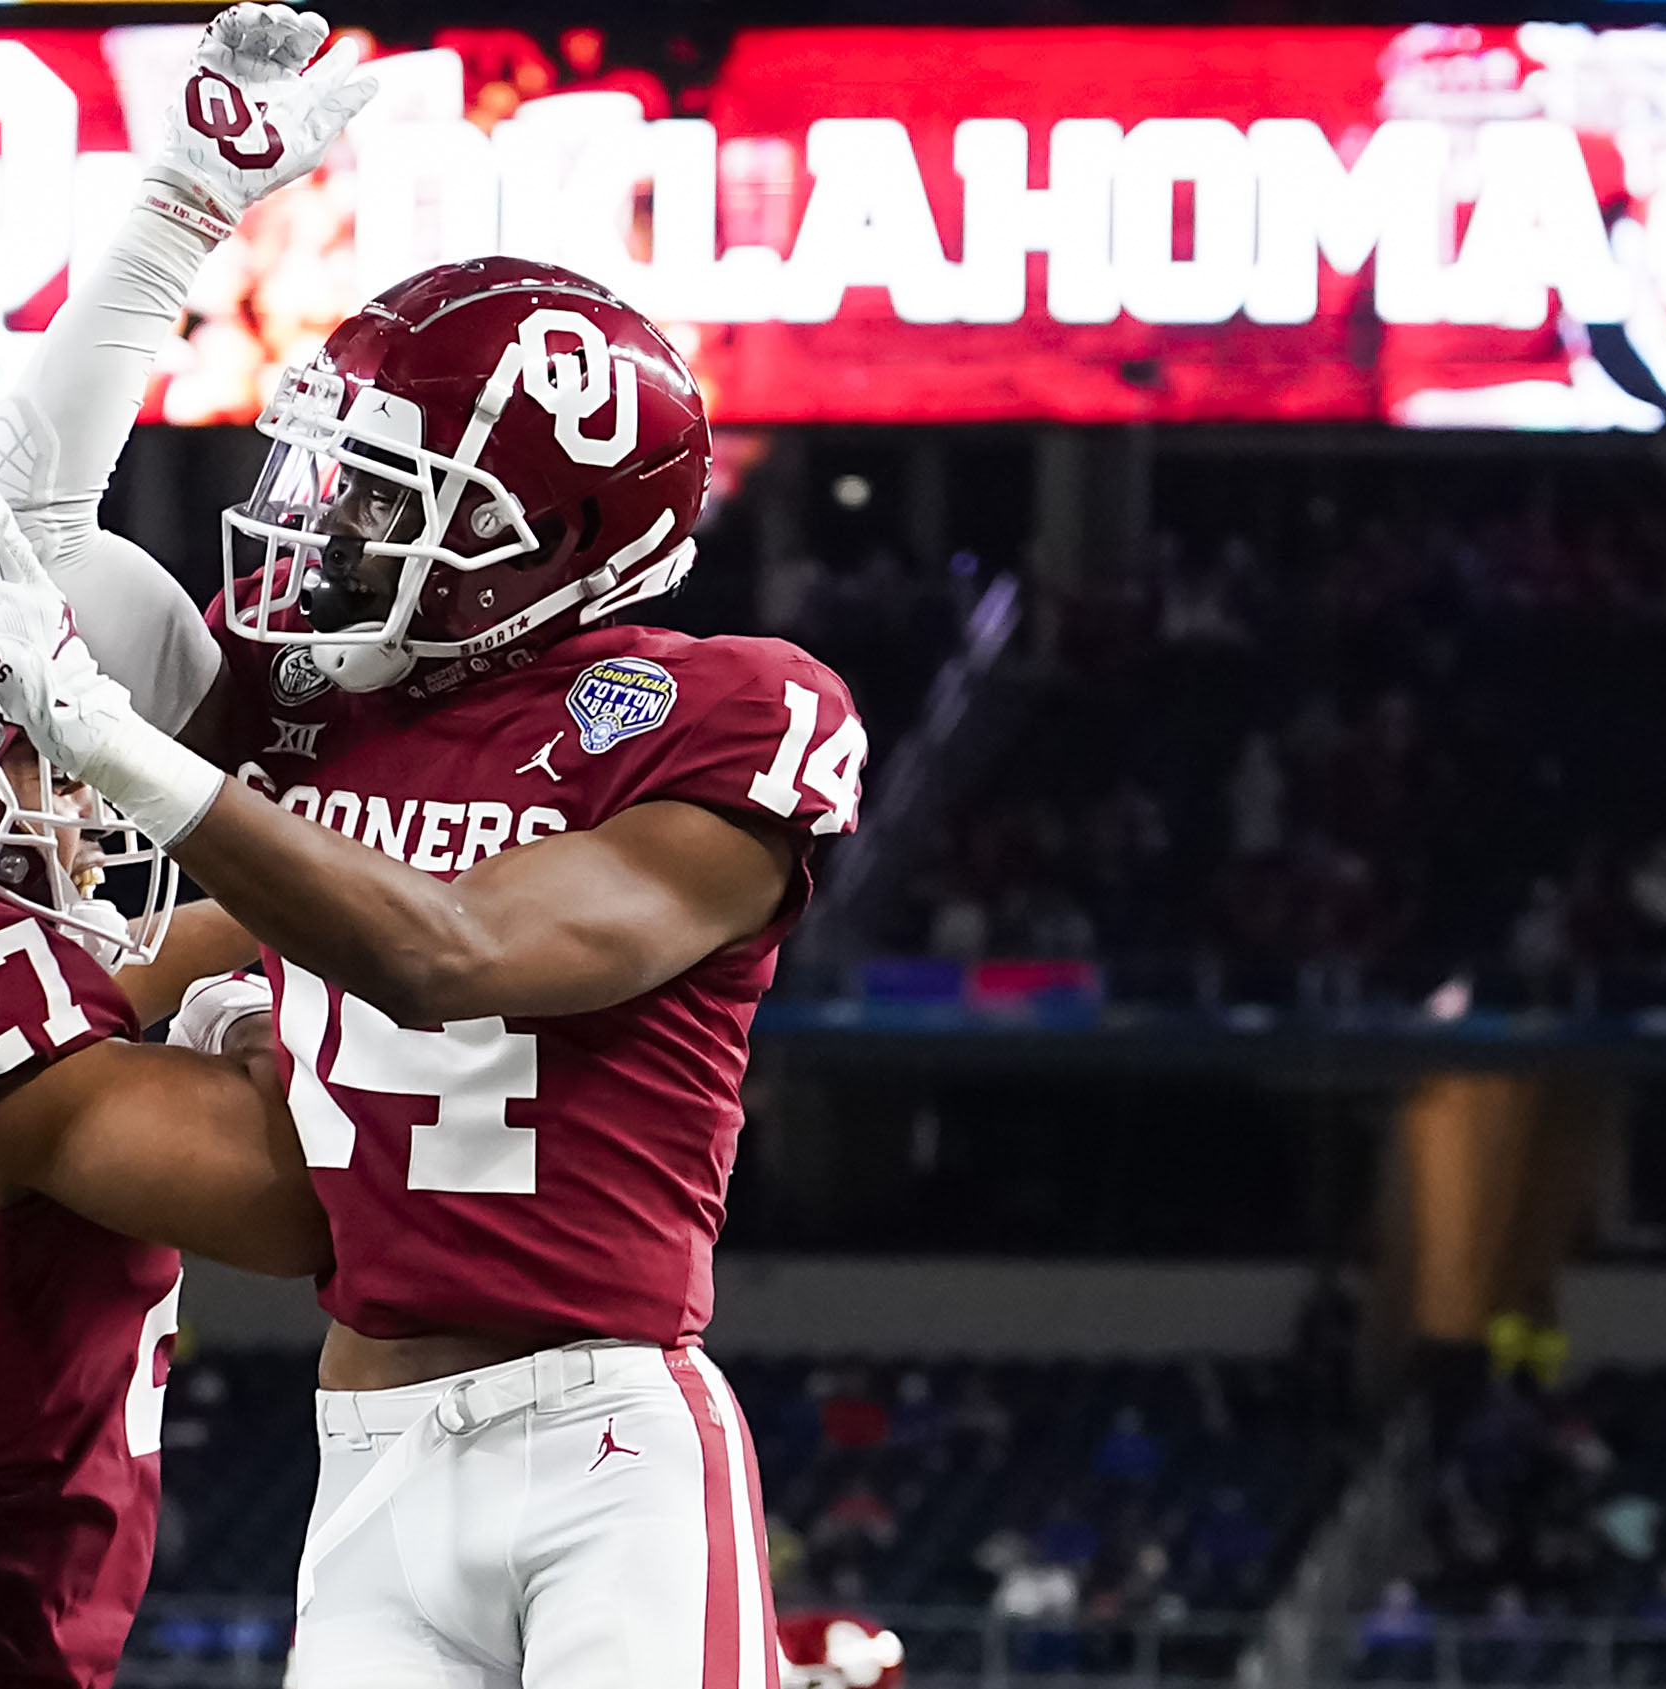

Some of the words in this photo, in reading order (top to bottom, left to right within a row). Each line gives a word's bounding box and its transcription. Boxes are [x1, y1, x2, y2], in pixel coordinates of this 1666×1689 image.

[185, 66, 285, 169] OU
[355, 119, 1630, 324] OKLAHOMA
[518, 308, 638, 467] OU
[578, 678, 664, 722] COTTON
[587, 698, 638, 725] BOWL
[747, 680, 868, 836] 14
